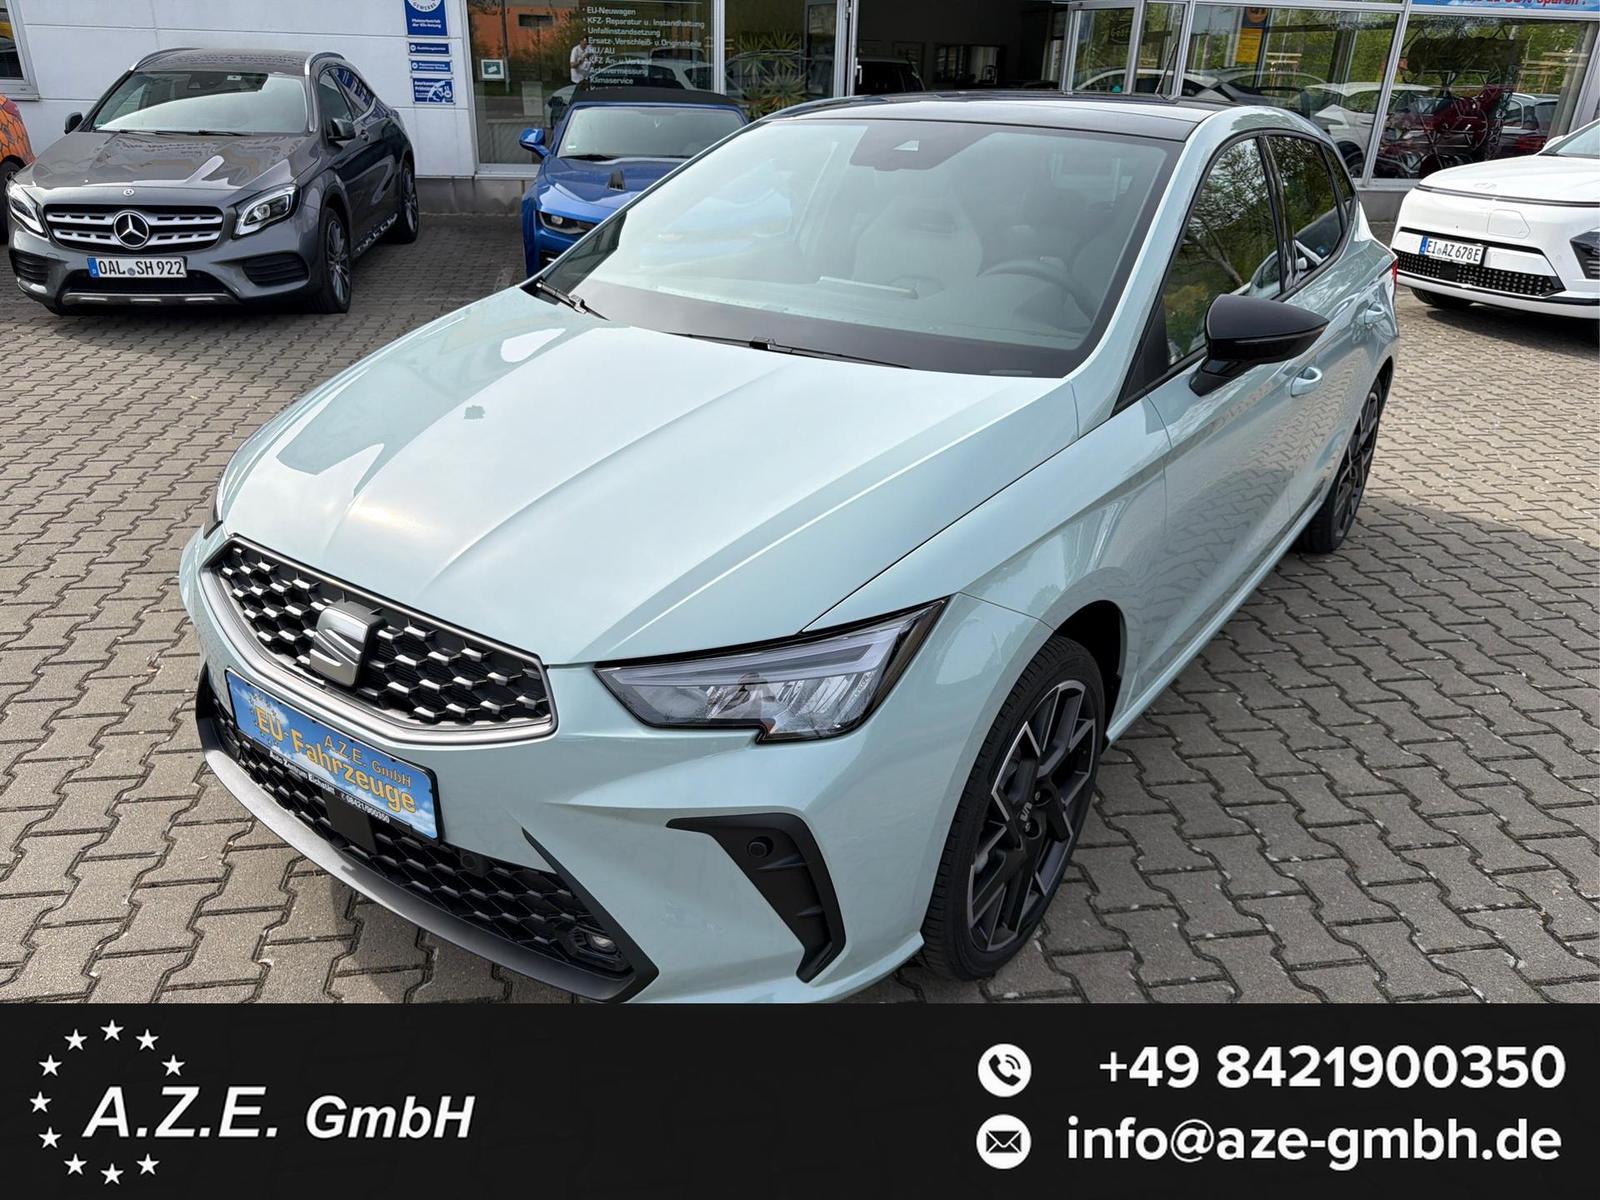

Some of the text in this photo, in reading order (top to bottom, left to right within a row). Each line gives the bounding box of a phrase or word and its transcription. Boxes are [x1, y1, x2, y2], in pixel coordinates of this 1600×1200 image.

[1442, 243, 1455, 258] AZ
[1455, 245, 1481, 262] 678E
[98, 260, 184, 276] OAL SH 922
[371, 760, 412, 787] GmbH
